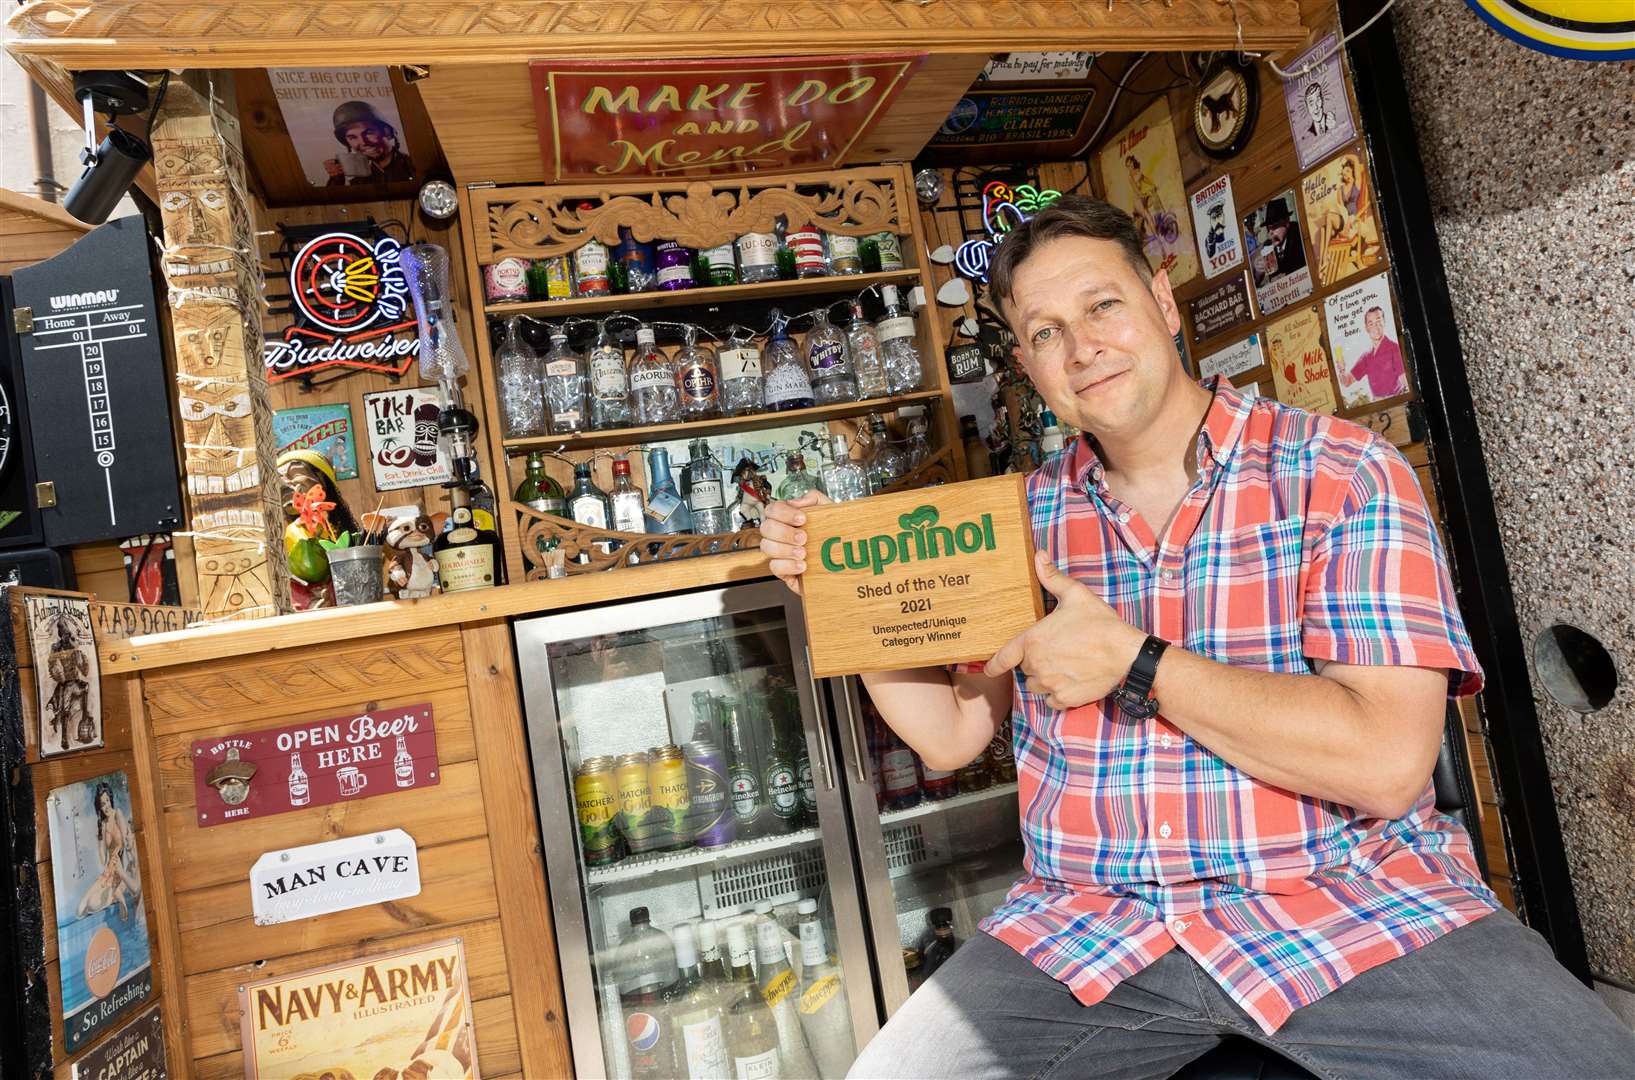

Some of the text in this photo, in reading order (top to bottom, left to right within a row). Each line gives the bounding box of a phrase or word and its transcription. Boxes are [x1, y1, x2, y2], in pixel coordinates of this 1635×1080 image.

[1014, 58, 1022, 69] to
[1021, 62, 1038, 74] pay
[1038, 58, 1053, 73] for
[276, 72, 380, 84] NICE BIG CUP OF
[275, 86, 393, 99] SHUT THE FUCK UP
[580, 76, 876, 114] MAKE DO
[673, 119, 760, 136] AND
[1004, 119, 1051, 130] CLAIRE
[594, 120, 813, 175] Mend
[1195, 178, 1227, 204] BRITONS
[1304, 175, 1327, 193] Hello
[1310, 183, 1338, 205] Sailor
[1210, 249, 1237, 269] YOU
[50, 289, 117, 309] WINMAU
[1194, 292, 1243, 321] BACKYARD BAR
[1270, 289, 1300, 309] Moretti
[1328, 287, 1364, 307] Of course
[1340, 302, 1345, 312] I
[1345, 298, 1362, 311] love
[45, 311, 131, 330] Home Away
[1334, 307, 1364, 325] Now get
[72, 324, 141, 342] 01 01
[1337, 322, 1348, 331] me
[86, 346, 98, 356] 20
[261, 334, 421, 368] Budweiser
[810, 344, 843, 365] WHITBY
[951, 348, 980, 364] BORN TO
[1303, 350, 1323, 366] Milk
[88, 363, 100, 374] 19
[956, 357, 979, 376] RUM
[1304, 366, 1328, 384] Shake
[91, 381, 103, 392] 18
[93, 399, 105, 410] 17
[368, 394, 414, 419] TIKI
[95, 418, 107, 428] 16
[376, 417, 405, 435] BAR
[97, 436, 109, 446] 15
[820, 507, 997, 576] Cuprinol
[856, 573, 971, 599] Shed of the Year
[899, 598, 932, 614] 2021
[141, 606, 177, 635] DOG
[872, 615, 968, 636] Unexpected/Unique
[881, 629, 963, 649] Category Winner
[276, 713, 419, 752] OPEN Beer
[210, 739, 253, 755] BOTTLE
[317, 742, 383, 770] HERE
[577, 796, 615, 809] HATCHERS
[619, 788, 651, 799] HATCHE
[224, 807, 250, 818] HERE
[263, 855, 410, 899] MAN CAVE
[257, 955, 457, 1031] NAVY & ARMY
[82, 982, 145, 1033] So Refreshing
[353, 994, 436, 1020] ILLUSTRATED
[98, 1035, 149, 1080] CAPTAIN
